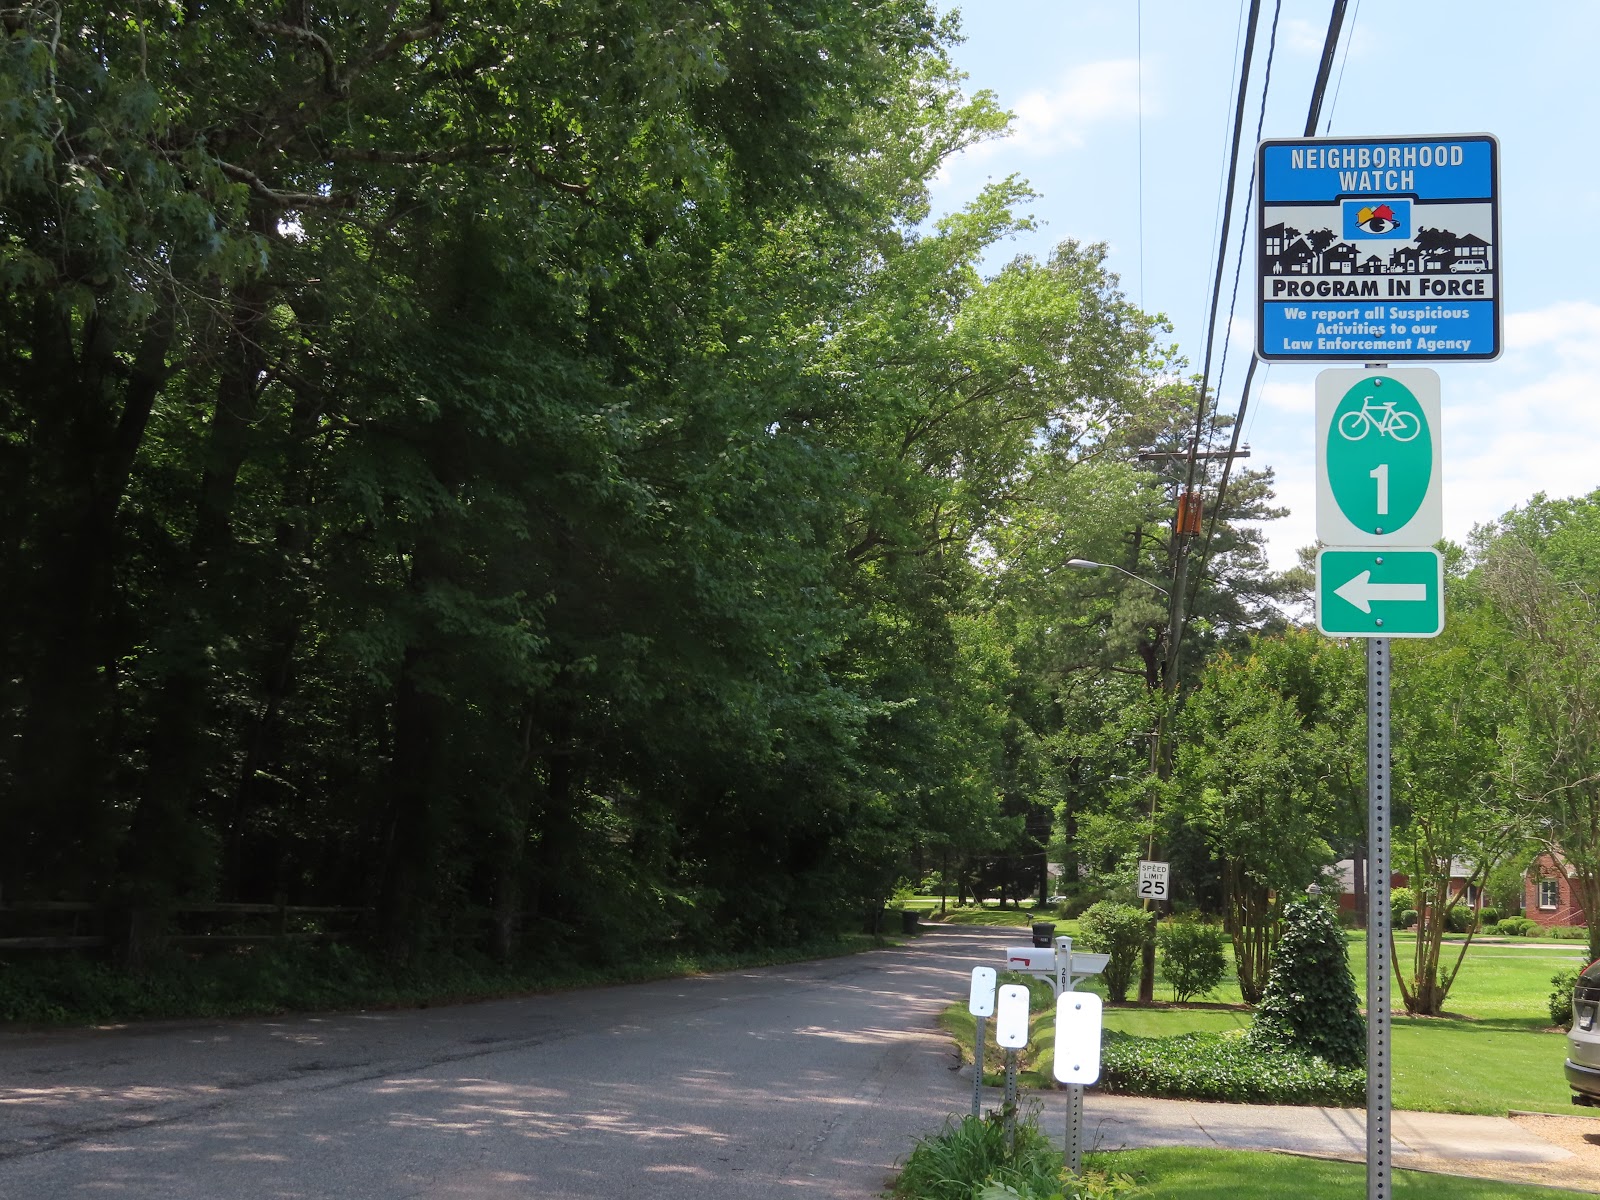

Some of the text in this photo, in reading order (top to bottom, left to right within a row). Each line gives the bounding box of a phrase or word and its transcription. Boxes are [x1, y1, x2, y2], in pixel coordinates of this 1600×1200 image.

[1291, 145, 1464, 170] NEIGHBORHOOD
[1338, 169, 1415, 191] WATCH
[1272, 278, 1485, 297] PROGRAM IN FORCE
[1284, 306, 1470, 322] We report all Suspicious
[1315, 322, 1438, 336] Activities to our
[1283, 337, 1472, 352] Law Enforcement Agency
[1369, 463, 1389, 515] 1
[1141, 864, 1167, 873] SPEED
[1143, 872, 1163, 880] LIMIT
[1141, 880, 1165, 895] 25
